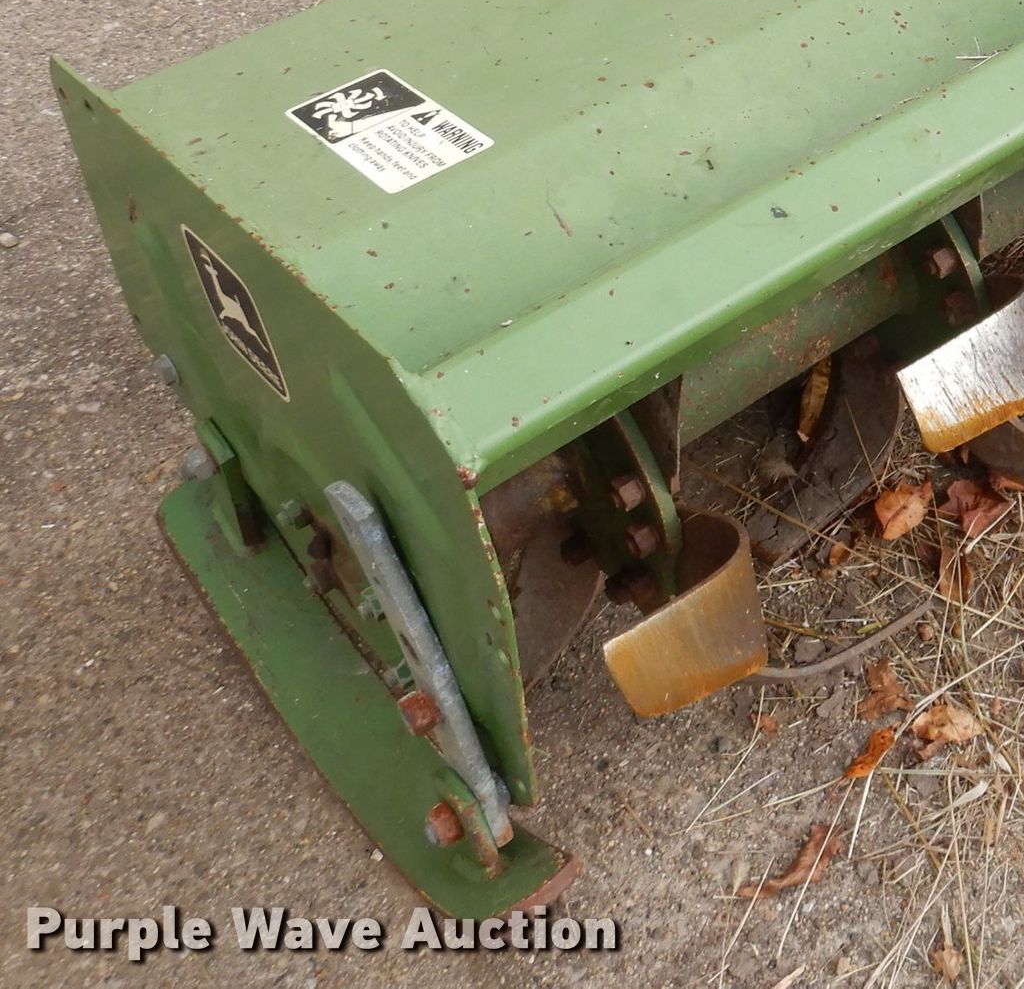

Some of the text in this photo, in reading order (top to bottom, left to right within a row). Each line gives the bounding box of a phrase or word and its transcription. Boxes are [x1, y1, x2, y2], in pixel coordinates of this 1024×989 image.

[387, 124, 447, 167] AVOID INJURY FROM
[398, 119, 426, 138] TO HELP
[431, 119, 485, 154] WARNING
[347, 142, 373, 161] clothing
[375, 129, 429, 168] ROTATING KNIVES
